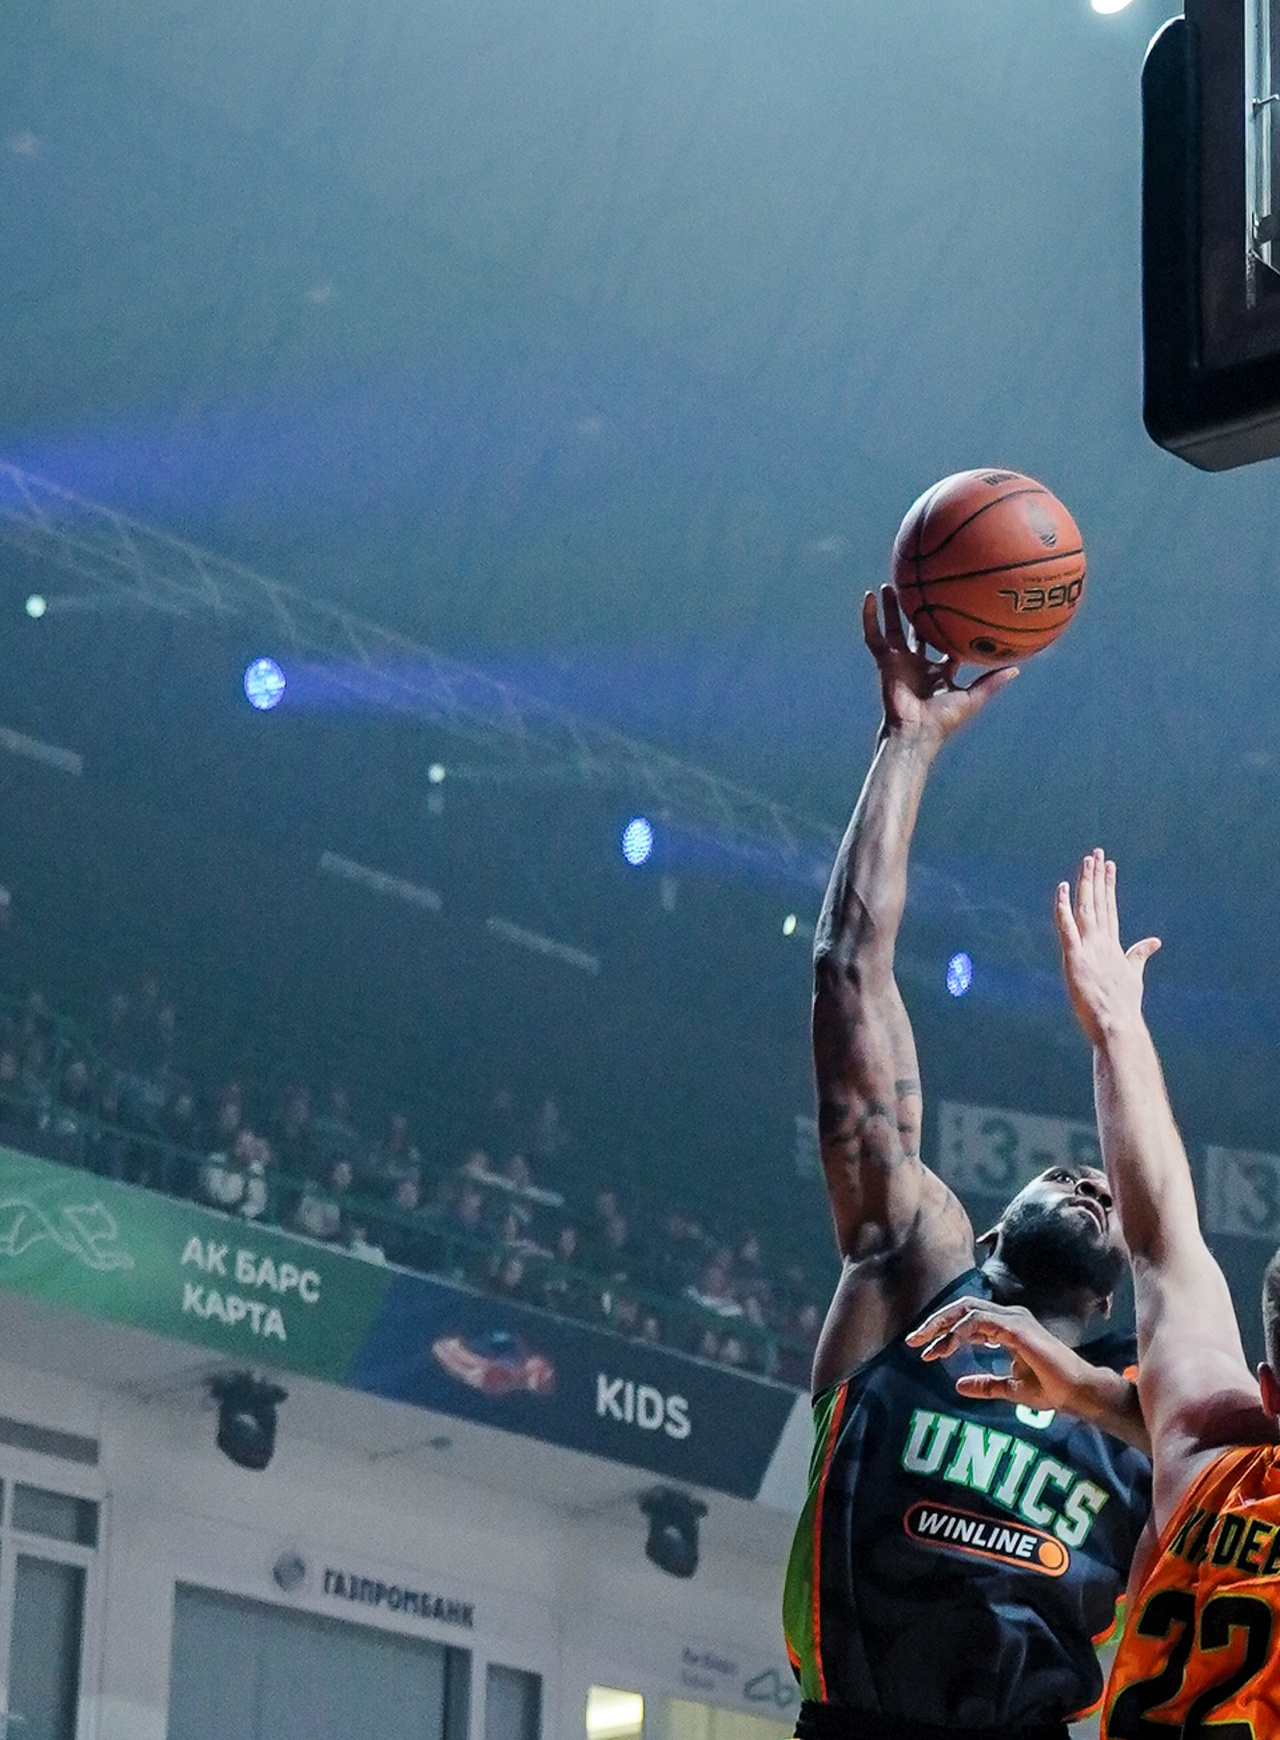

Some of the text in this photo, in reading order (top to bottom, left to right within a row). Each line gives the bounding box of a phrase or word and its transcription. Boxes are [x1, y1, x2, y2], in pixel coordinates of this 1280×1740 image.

[180, 1236, 322, 1303] АК БАРС
[181, 1282, 287, 1342] КАРТА
[596, 1373, 692, 1440] KIDS
[902, 1408, 1109, 1550] UNICS
[917, 1510, 1038, 1558] WINLINE
[324, 1568, 476, 1629] ГАЗПРОМБАНК
